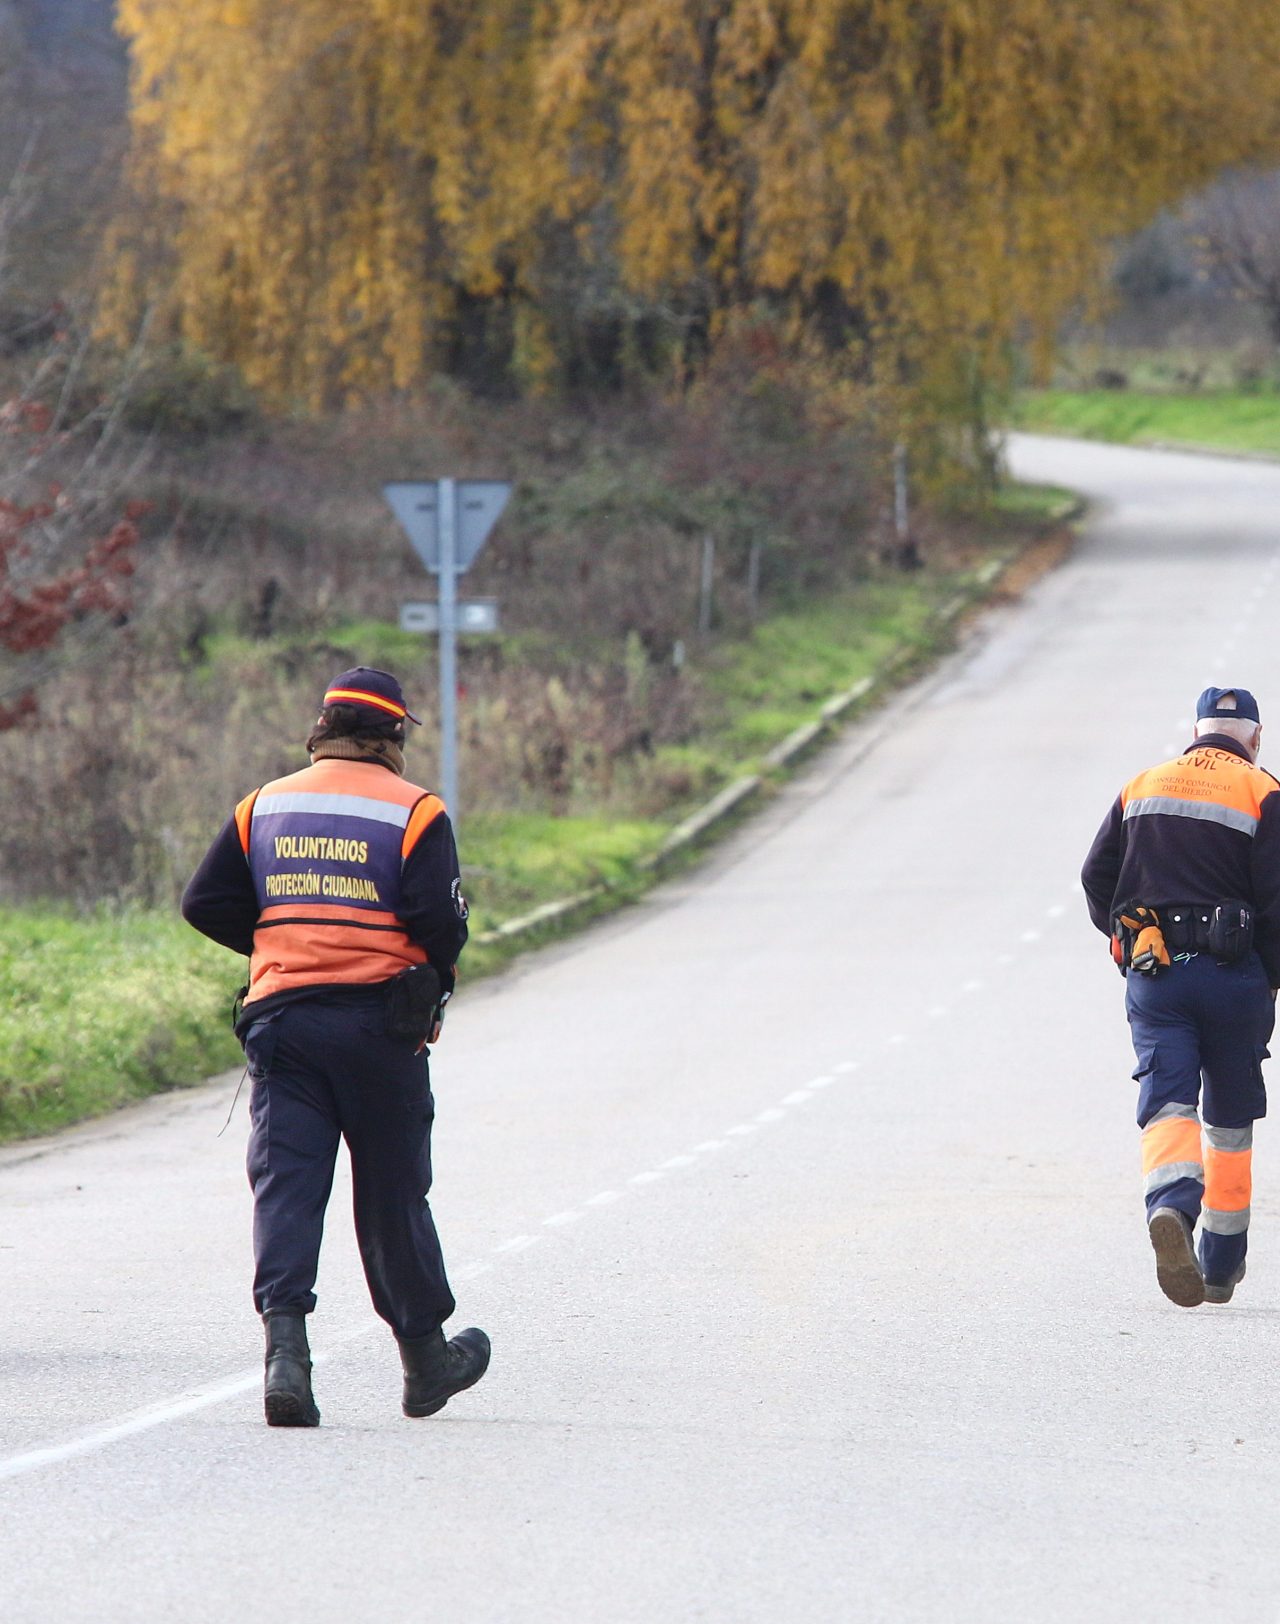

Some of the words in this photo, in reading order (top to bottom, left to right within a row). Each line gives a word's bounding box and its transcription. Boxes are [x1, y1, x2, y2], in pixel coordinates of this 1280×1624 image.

[1177, 757, 1216, 770] CIVIL
[1162, 784, 1179, 793] DEL
[274, 836, 368, 864] VOLUNTARIOS
[265, 868, 320, 897] PROTECCIÓN
[322, 875, 380, 902] CIUDADANA
